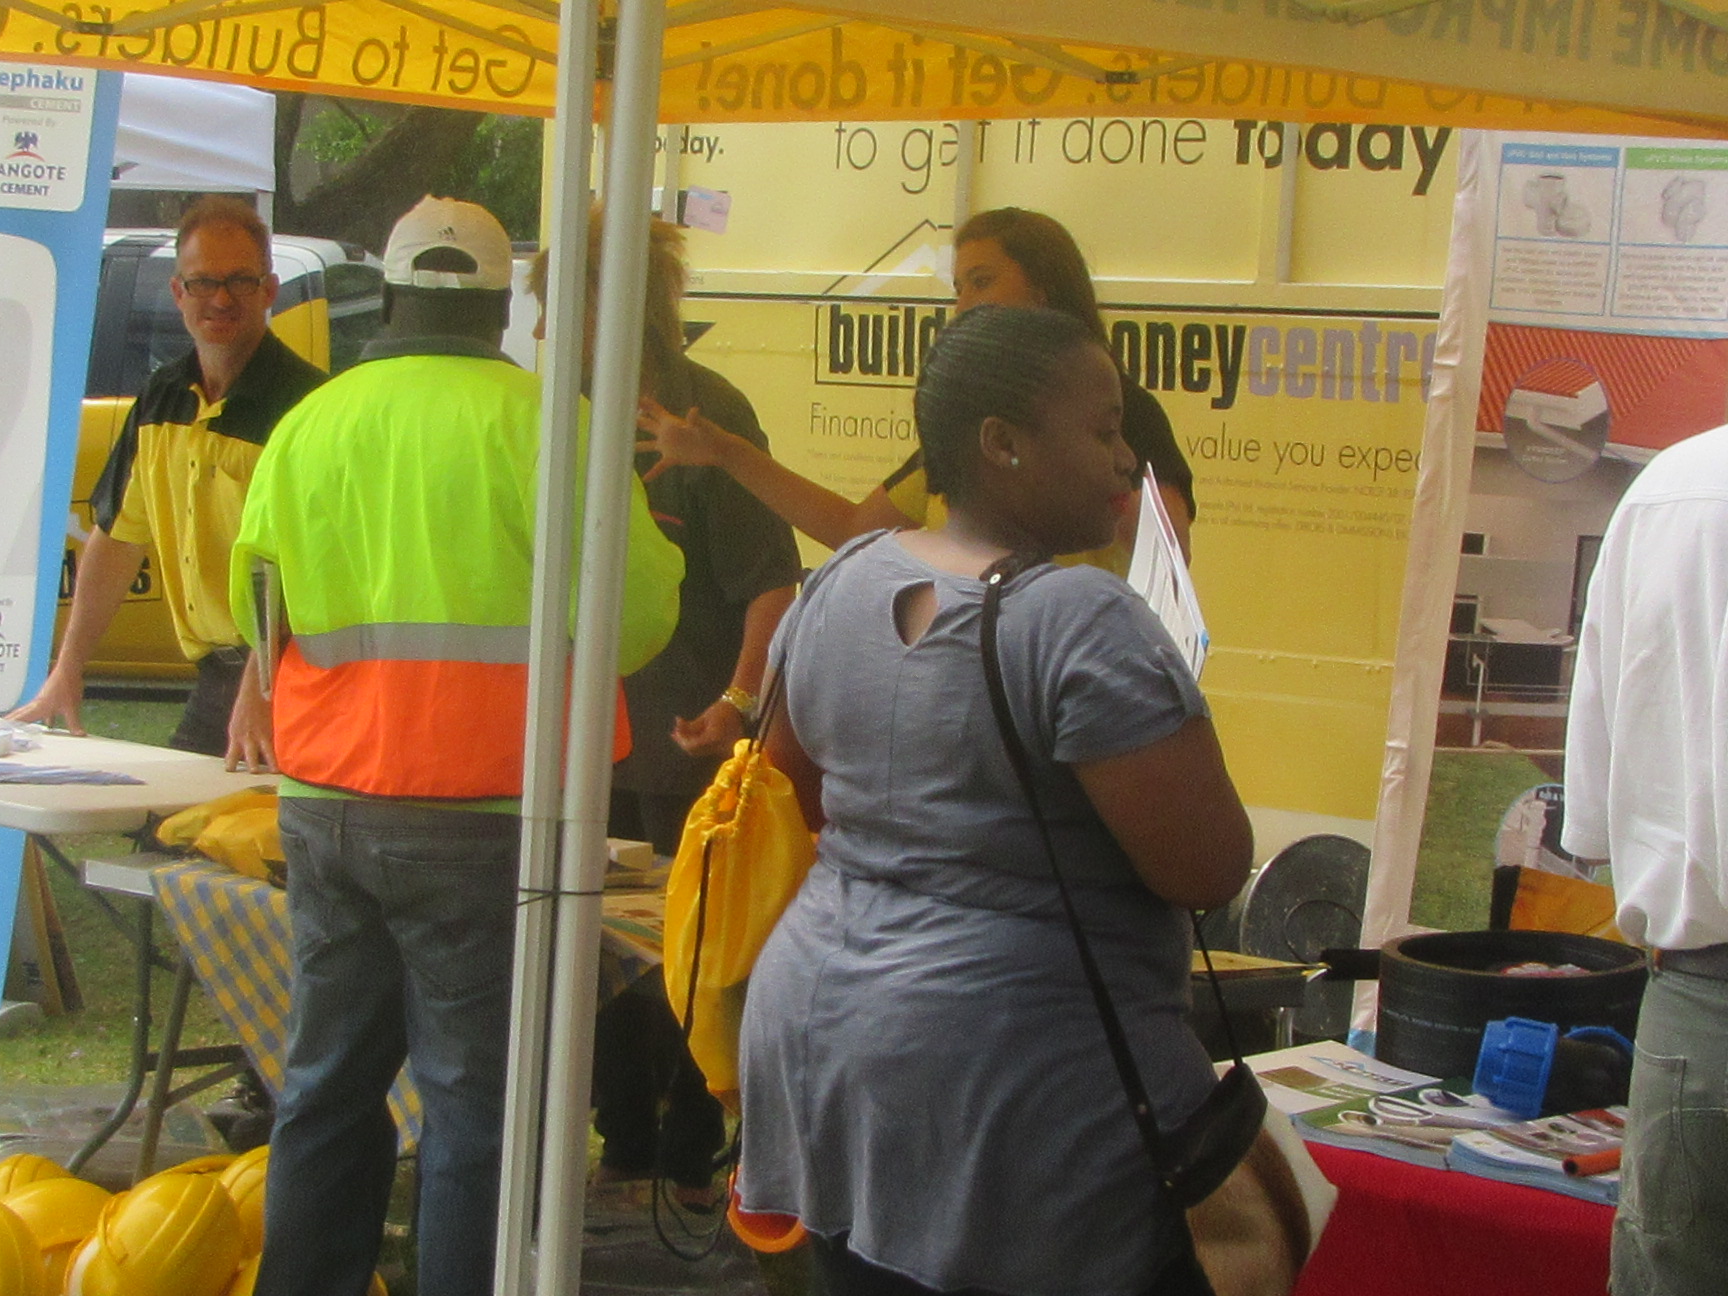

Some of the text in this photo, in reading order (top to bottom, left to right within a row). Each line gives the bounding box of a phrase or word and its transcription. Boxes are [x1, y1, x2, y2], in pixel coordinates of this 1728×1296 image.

[833, 122, 878, 171] to
[1062, 118, 1209, 165] done
[0, 182, 50, 197] CEMENT
[1186, 421, 1261, 463] value
[1273, 440, 1325, 476] you
